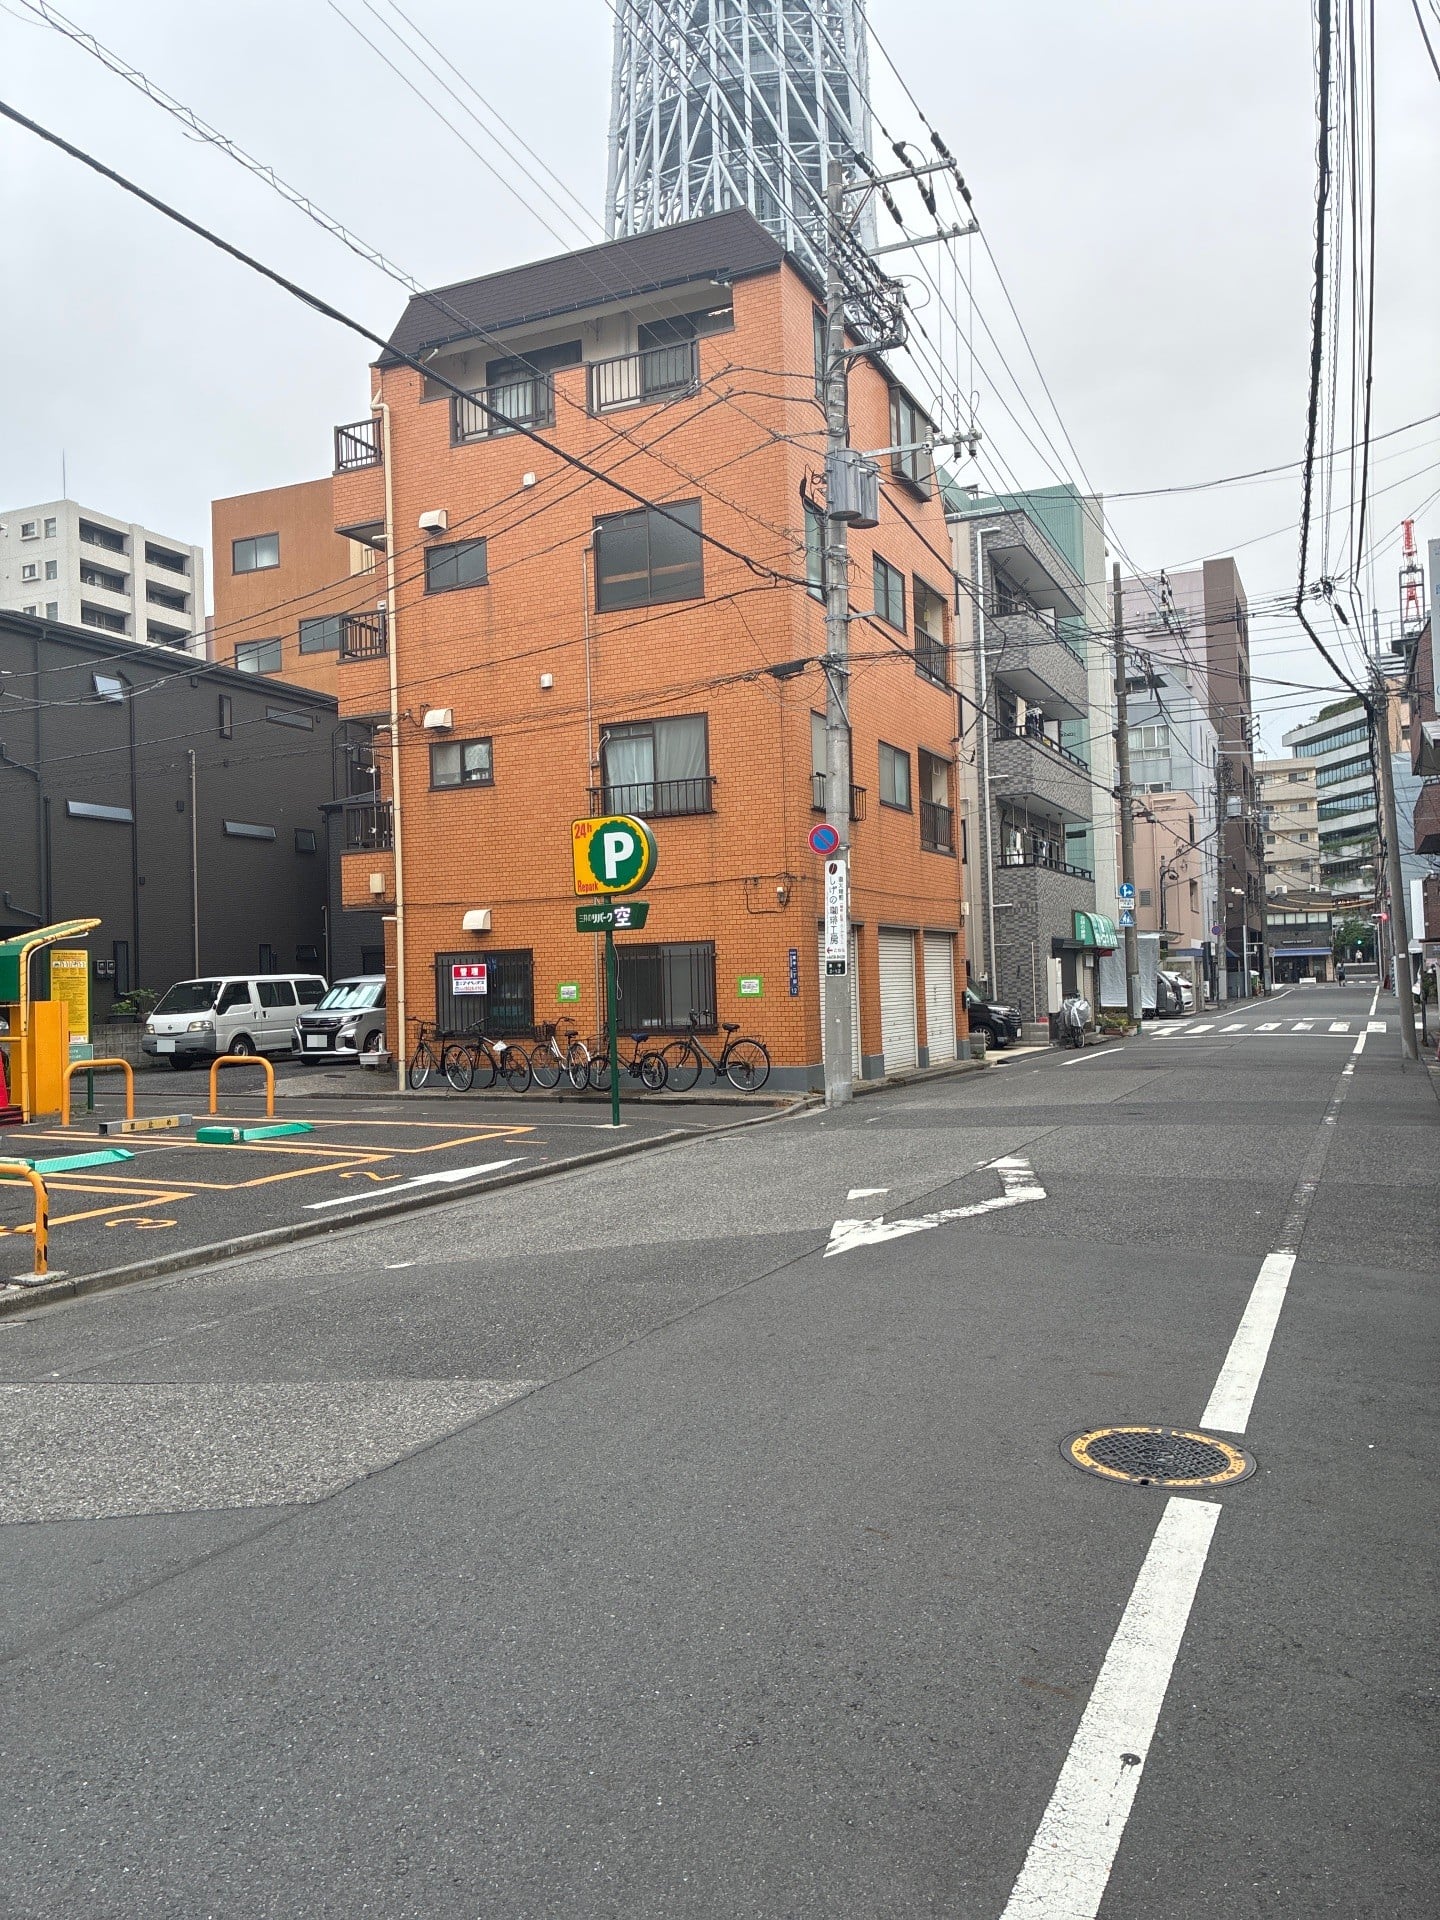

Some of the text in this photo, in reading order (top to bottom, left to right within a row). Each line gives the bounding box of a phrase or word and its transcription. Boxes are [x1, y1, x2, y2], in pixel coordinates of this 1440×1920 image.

[574, 823, 592, 839] 24h
[603, 831, 635, 879] P
[577, 880, 599, 893] Repark
[614, 906, 632, 928] 空
[338, 1171, 403, 1181] 2
[104, 1217, 178, 1228] 3
